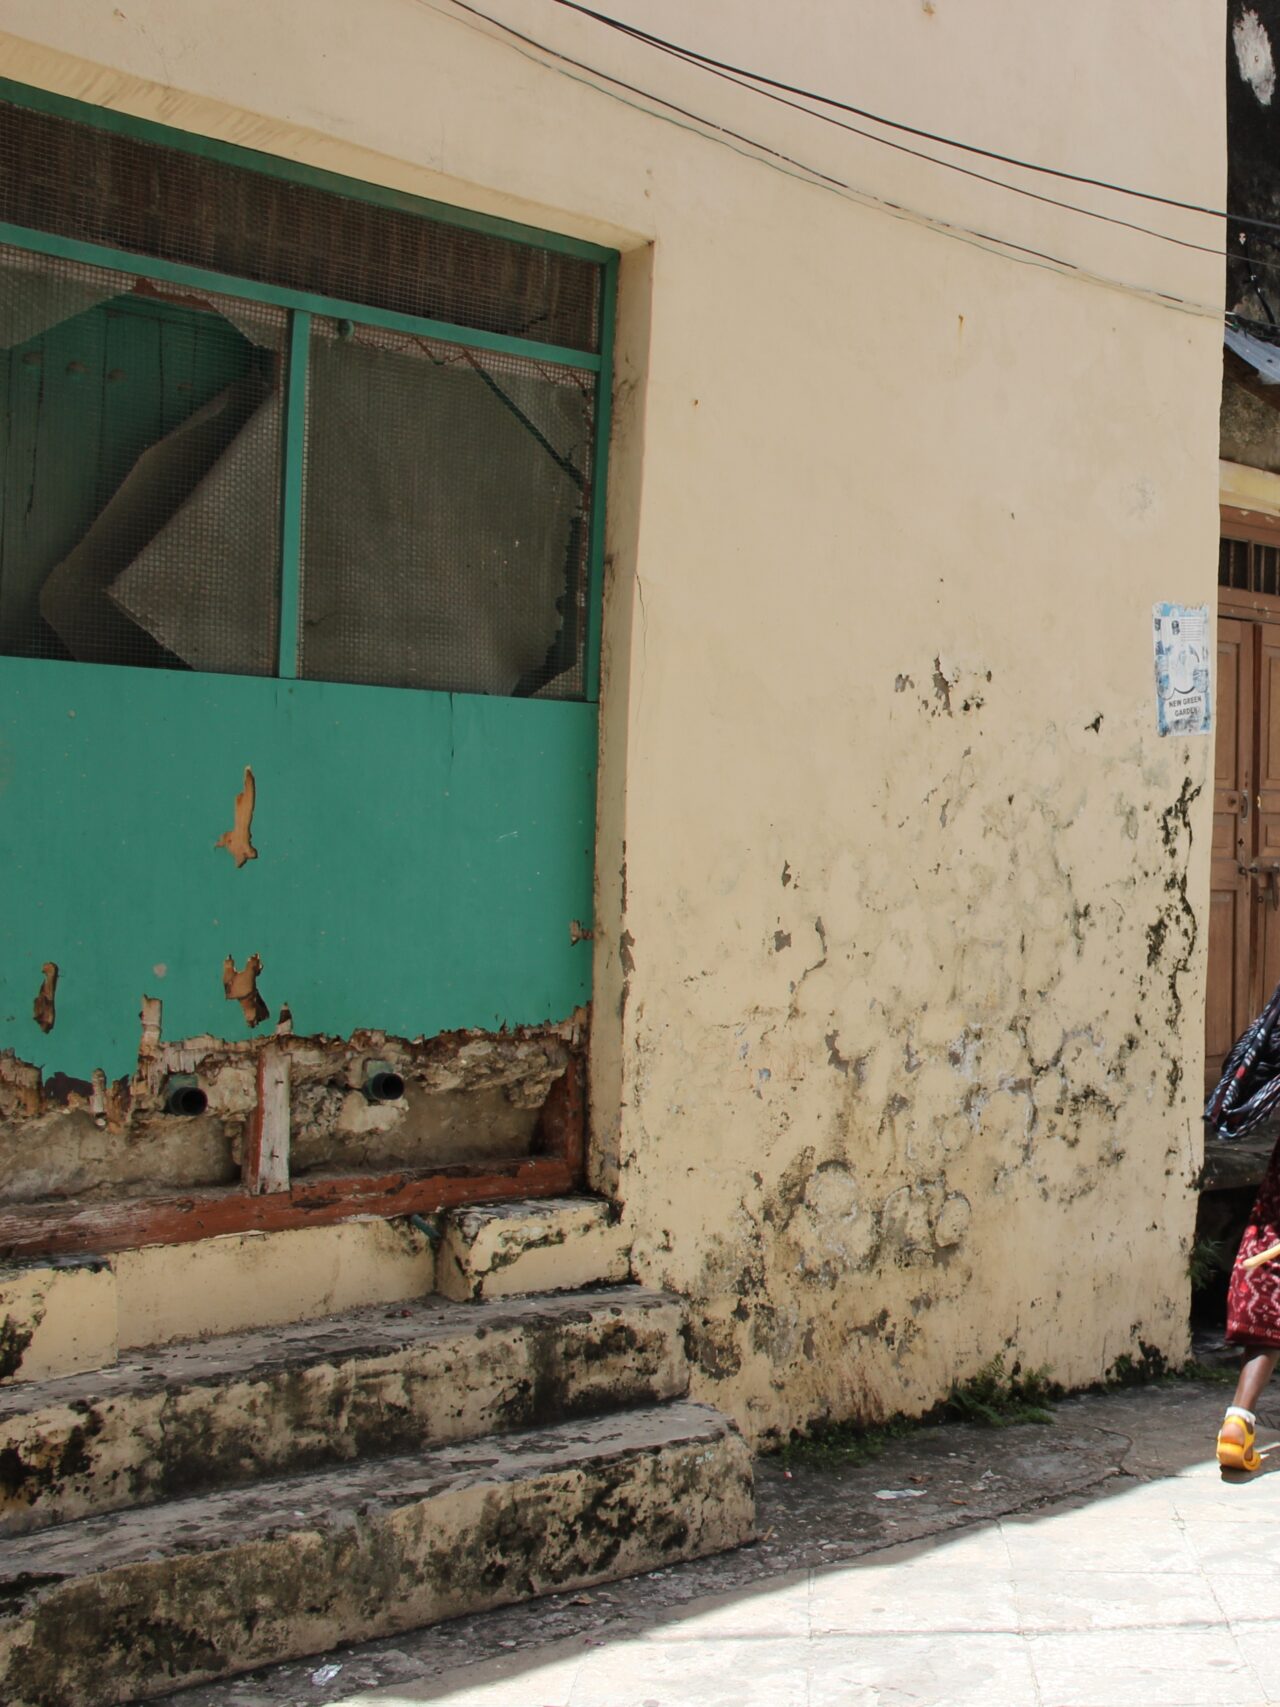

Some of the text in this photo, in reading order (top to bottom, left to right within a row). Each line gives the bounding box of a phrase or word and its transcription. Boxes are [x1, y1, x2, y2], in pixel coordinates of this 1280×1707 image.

[1169, 696, 1202, 708] NEW GREEN
[1174, 707, 1198, 717] GARDEN
